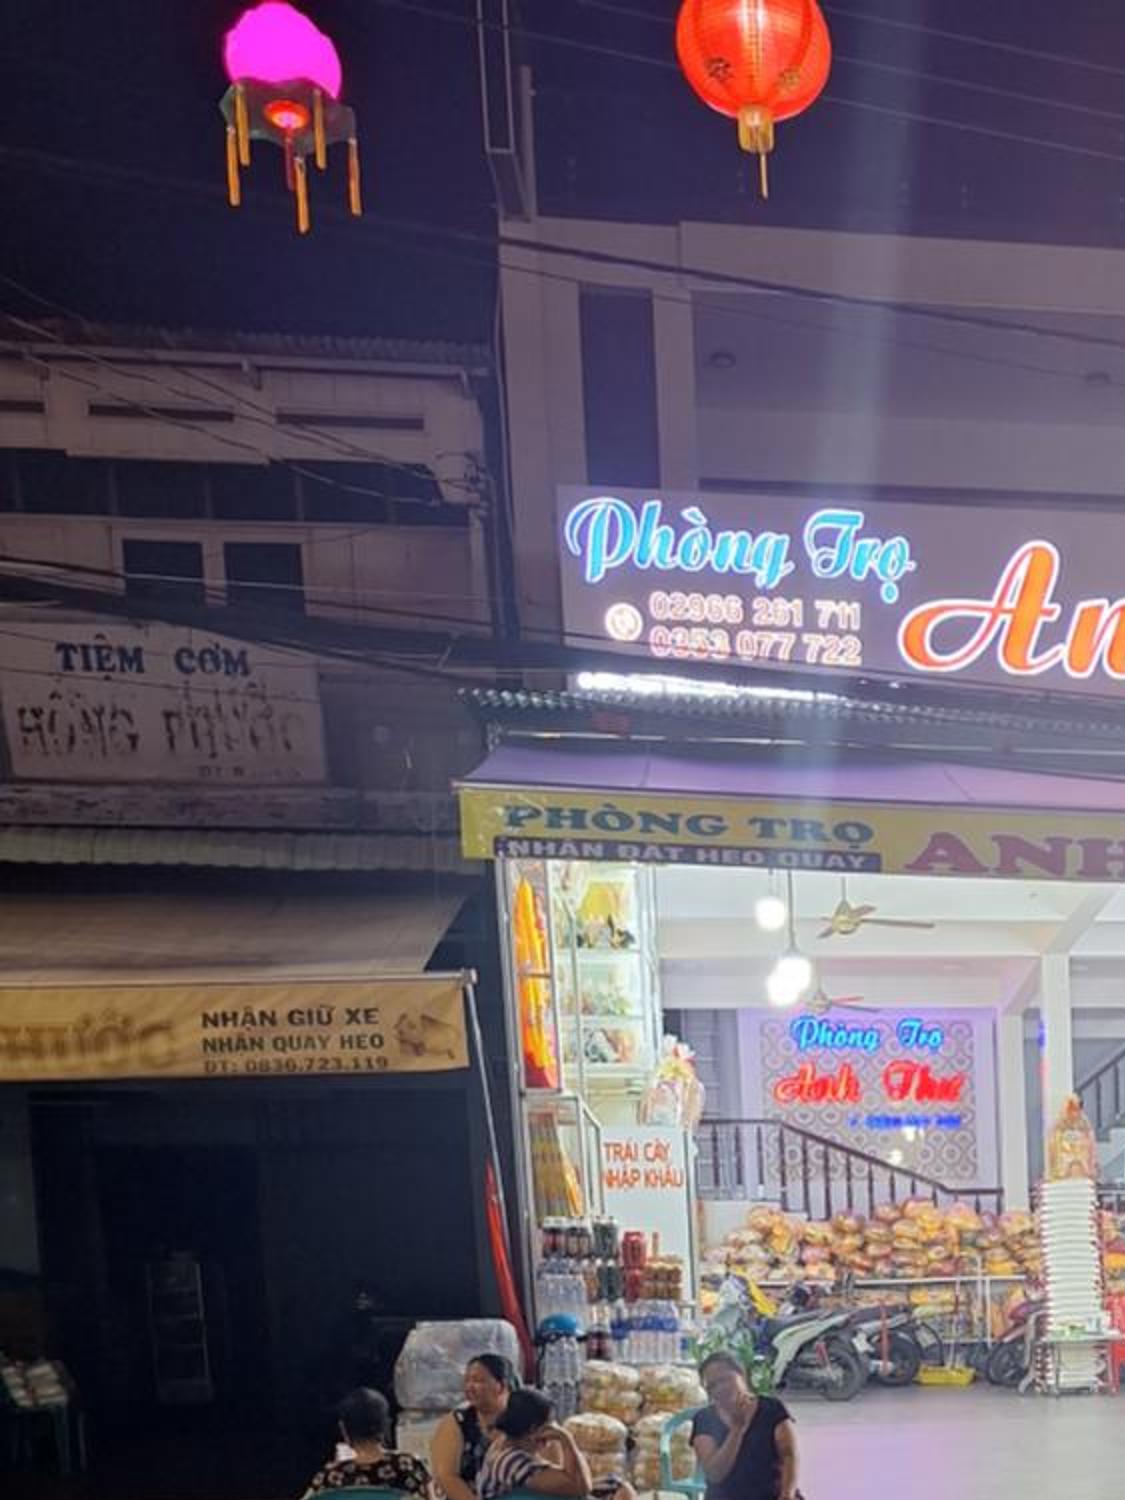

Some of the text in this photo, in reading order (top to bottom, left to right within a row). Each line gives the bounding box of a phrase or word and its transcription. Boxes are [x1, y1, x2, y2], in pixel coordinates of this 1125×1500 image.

[565, 496, 917, 603] Phòng Trọ
[814, 599, 862, 630] 711
[54, 632, 252, 681] TIỆM CƠM
[736, 630, 796, 661] 077
[802, 632, 863, 666] 722
[506, 803, 874, 849] PHÒNG TRỌ
[695, 847, 764, 866] HEO
[778, 850, 865, 870] QUAY
[202, 1004, 380, 1031] NHẬN GIỮ XE
[272, 1035, 331, 1053] QUAY
[340, 1033, 385, 1050] HEO
[789, 1014, 881, 1056] Phòng
[603, 1136, 672, 1163] TRÁI CÂY
